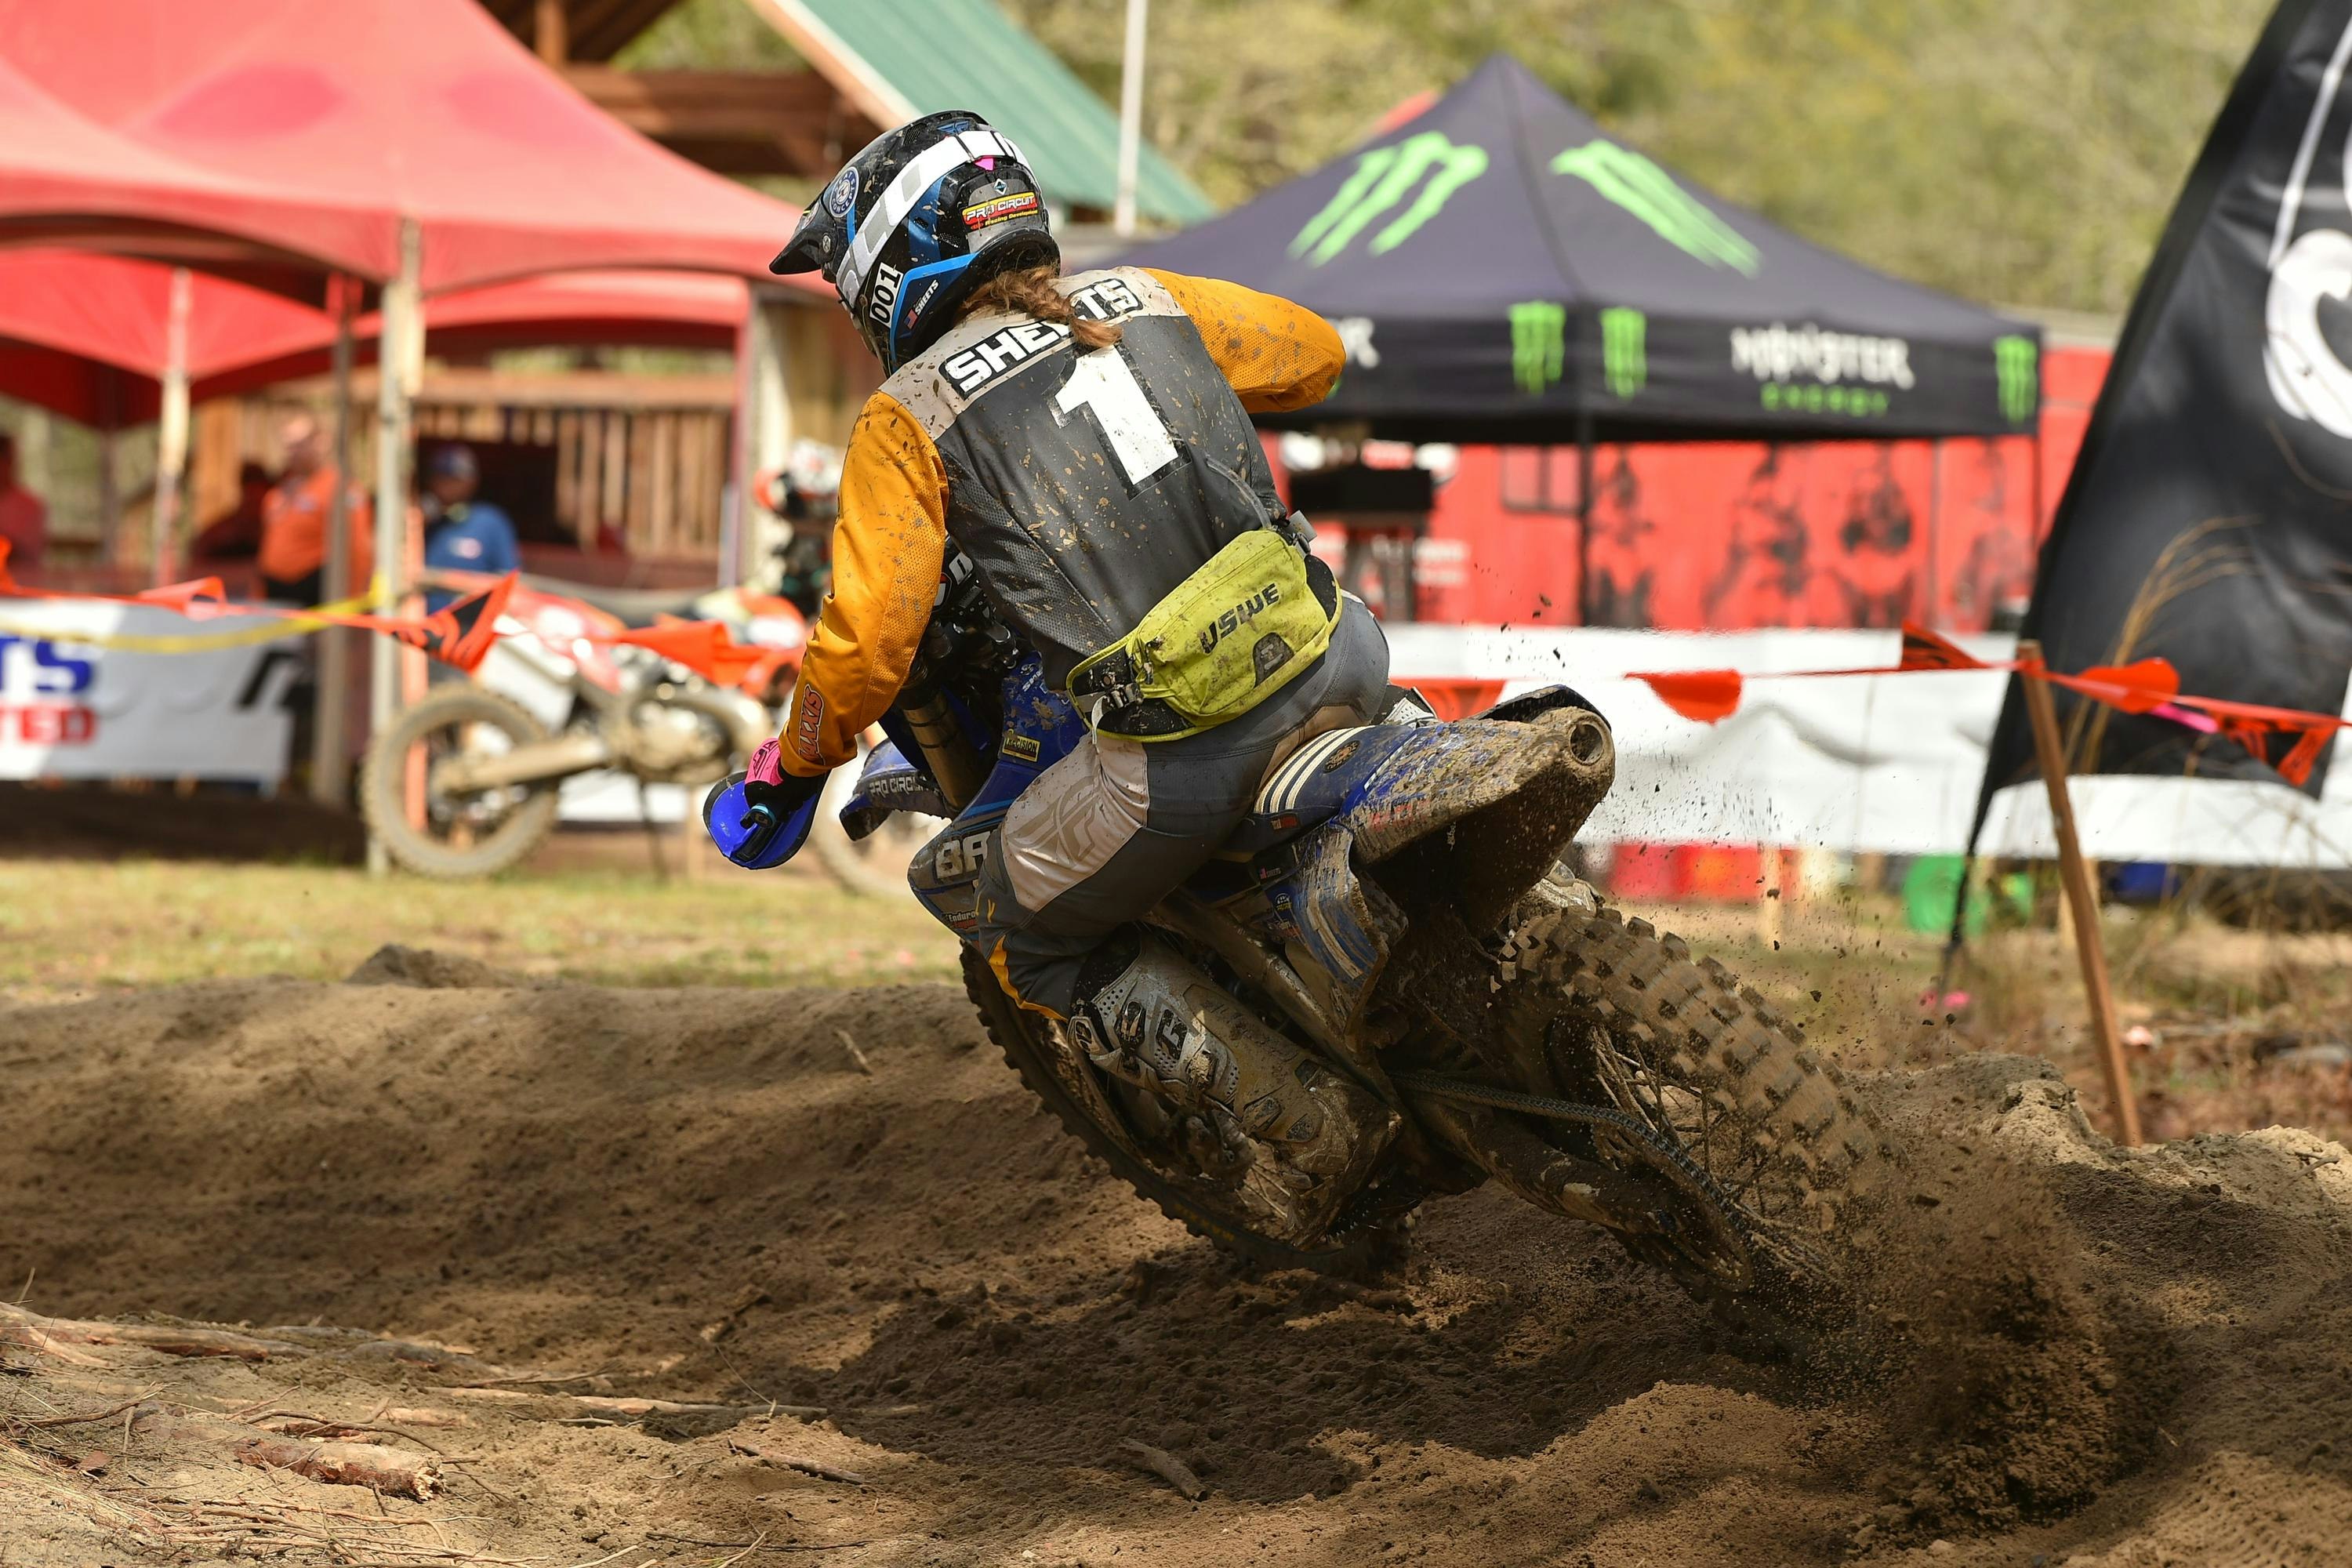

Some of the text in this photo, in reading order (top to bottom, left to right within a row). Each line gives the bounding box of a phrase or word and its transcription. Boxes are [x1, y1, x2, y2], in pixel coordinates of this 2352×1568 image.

[997, 196, 1034, 211] CIRCUIT
[985, 216, 1008, 226] Racing
[871, 268, 902, 324] 001
[915, 279, 939, 316] SHEETS
[1054, 345, 1180, 485] 1
[1200, 583, 1280, 654] USWE
[869, 776, 929, 798] PRO CIRC
[948, 910, 976, 923] Enduro
